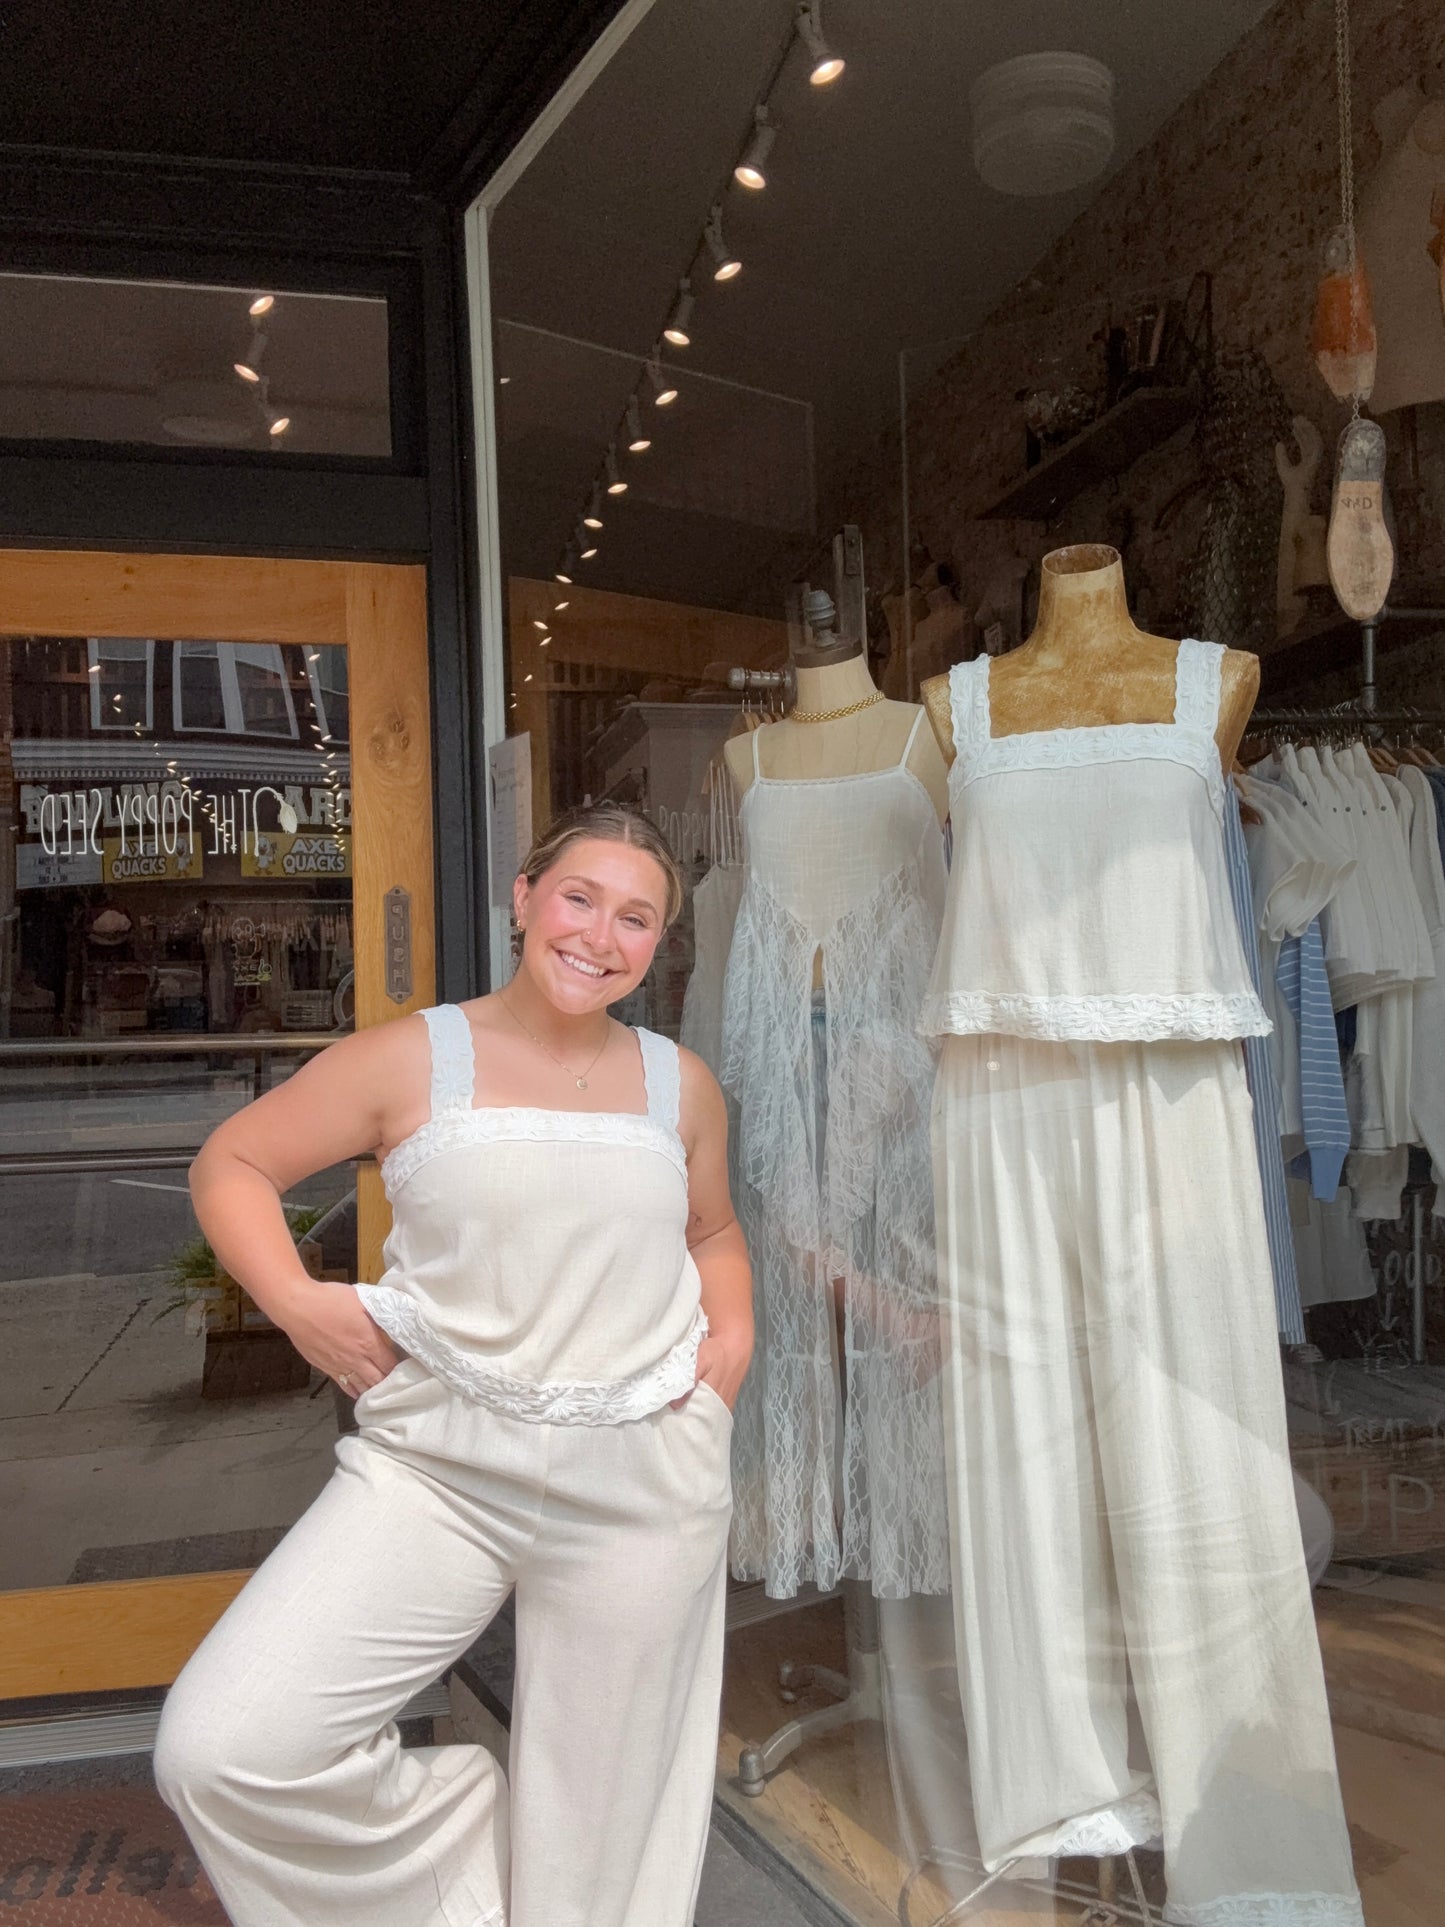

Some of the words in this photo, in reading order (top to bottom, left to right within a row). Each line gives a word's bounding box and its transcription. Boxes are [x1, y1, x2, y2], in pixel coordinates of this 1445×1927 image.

[291, 839, 338, 854] AXE
[111, 856, 167, 879] QUACKS
[282, 855, 345, 874] QUACKS
